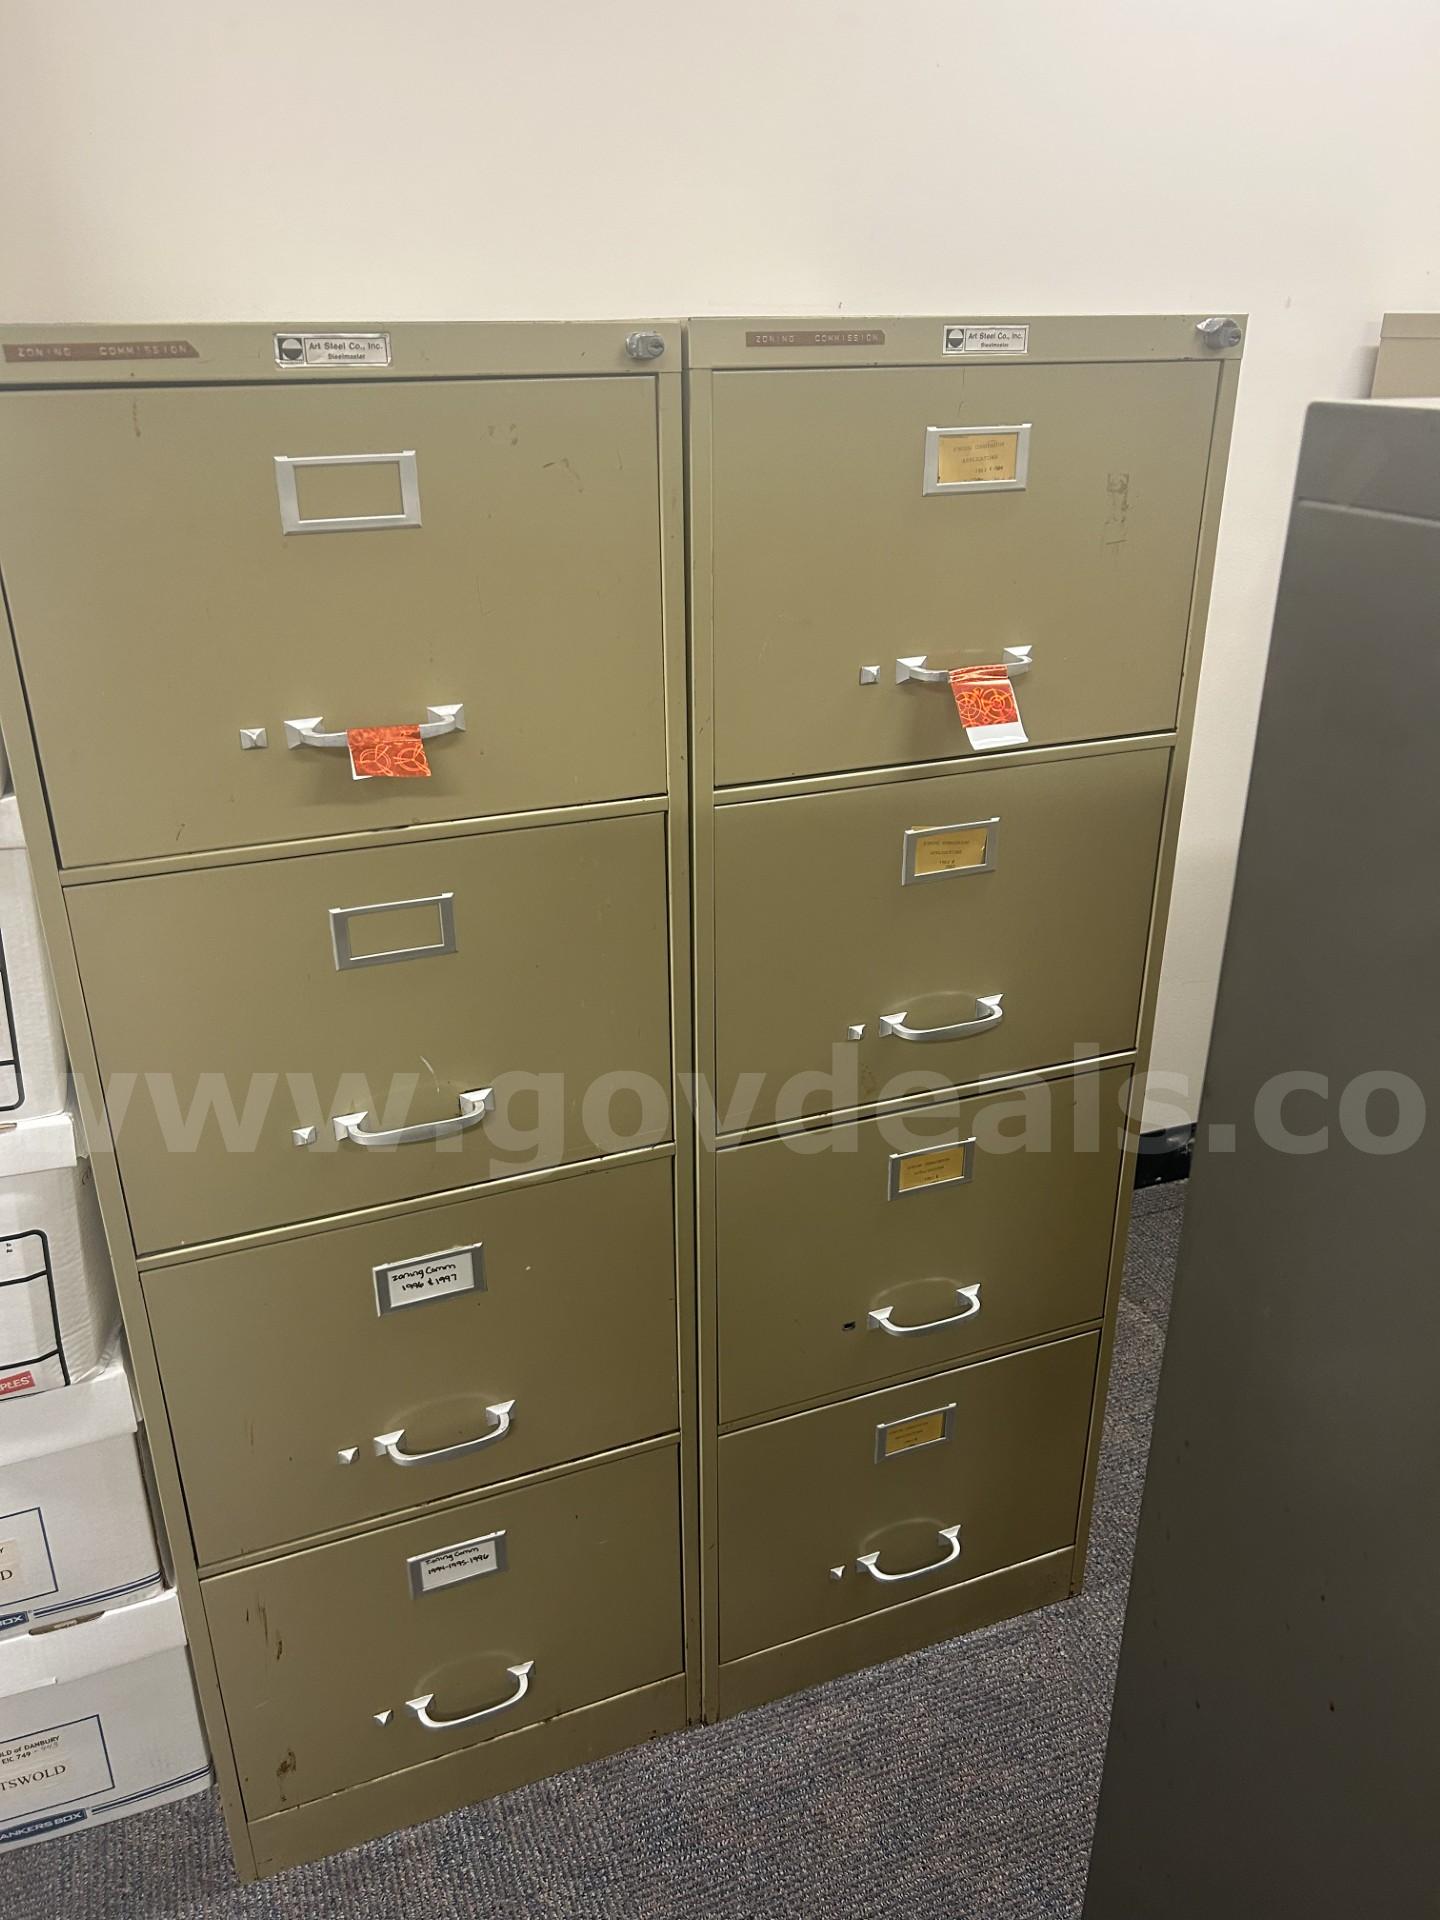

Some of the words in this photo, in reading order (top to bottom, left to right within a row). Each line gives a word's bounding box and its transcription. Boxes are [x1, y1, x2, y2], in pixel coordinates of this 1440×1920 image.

[755, 335, 795, 343] ZONING
[814, 333, 879, 343] COMMISSION
[18, 347, 72, 357] ZONING
[99, 345, 187, 356] COMMISSION
[309, 342, 321, 350] Art
[324, 342, 346, 350] Steel
[368, 341, 383, 350] Inc.
[425, 1264, 456, 1274] Comm
[402, 1281, 424, 1291] 1996
[435, 1273, 457, 1285] 1997
[24, 1735, 59, 1750] DANBURY
[16, 1751, 31, 1760] 749
[54, 1811, 82, 1825] BOX
